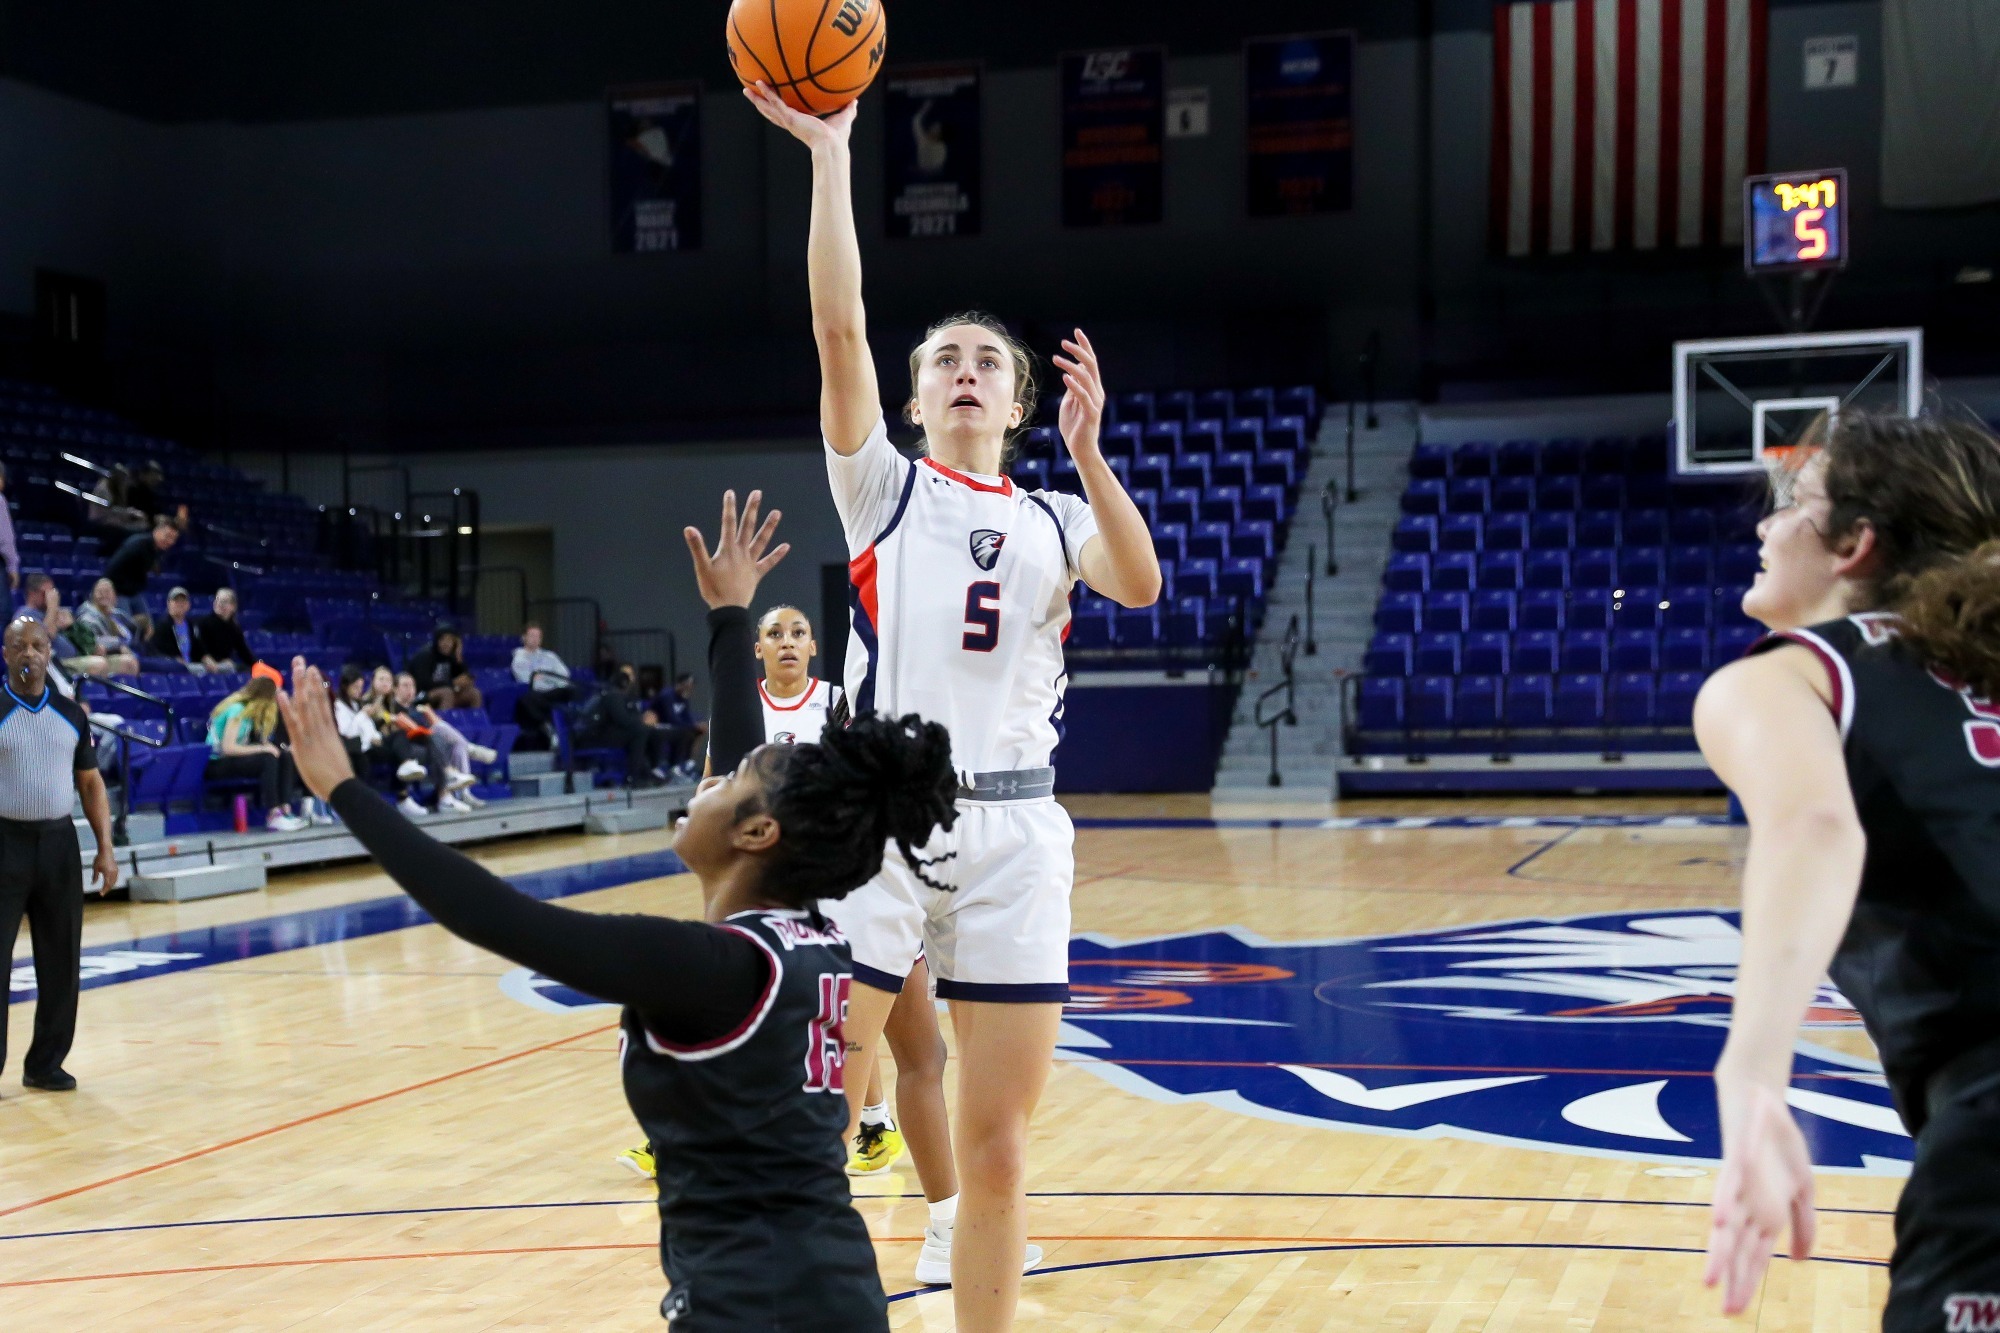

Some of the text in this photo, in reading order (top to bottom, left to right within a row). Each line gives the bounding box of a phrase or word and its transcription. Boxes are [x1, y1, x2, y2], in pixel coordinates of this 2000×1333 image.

[1795, 208, 1828, 260] 5
[962, 580, 1001, 653] 5
[802, 972, 853, 1094] 15
